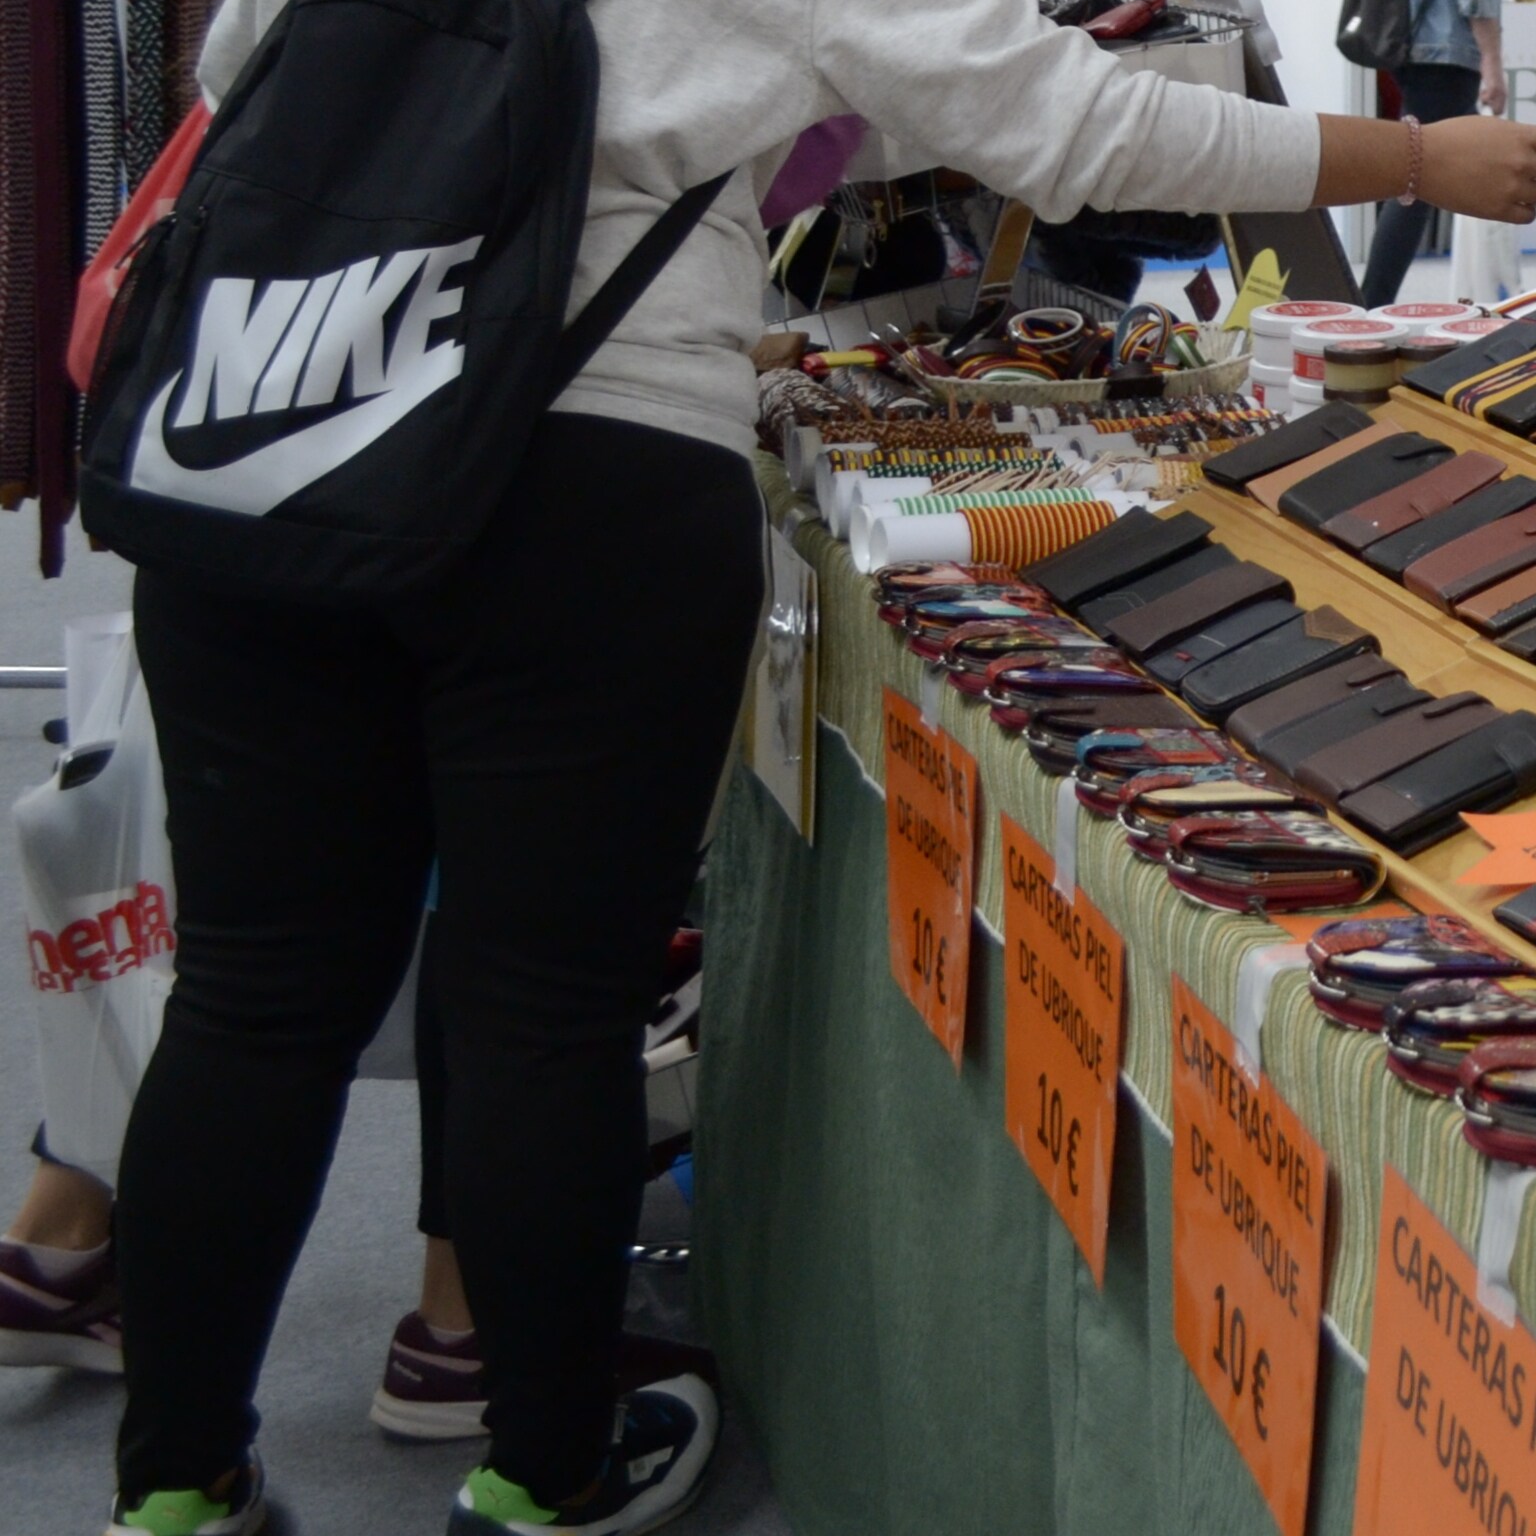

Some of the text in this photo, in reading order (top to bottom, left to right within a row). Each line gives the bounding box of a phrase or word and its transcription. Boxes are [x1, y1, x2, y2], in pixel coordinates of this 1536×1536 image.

[173, 234, 486, 429] NIKE
[888, 712, 947, 795] CARTERAS
[897, 794, 913, 843] DE
[912, 907, 947, 1006] 10 €
[1009, 845, 1113, 1003] CARTERAS PIEL
[1019, 938, 1104, 1084] DE UBRIQUE
[1037, 1072, 1082, 1197] 10 €
[1180, 1013, 1314, 1229] CARTERAS PIEL
[1191, 1123, 1299, 1318] DE UBRIQUE
[1213, 1283, 1271, 1442] 10 €
[1392, 1215, 1524, 1429] CARTERAS
[1396, 1345, 1534, 1536] DE UBRIQ
